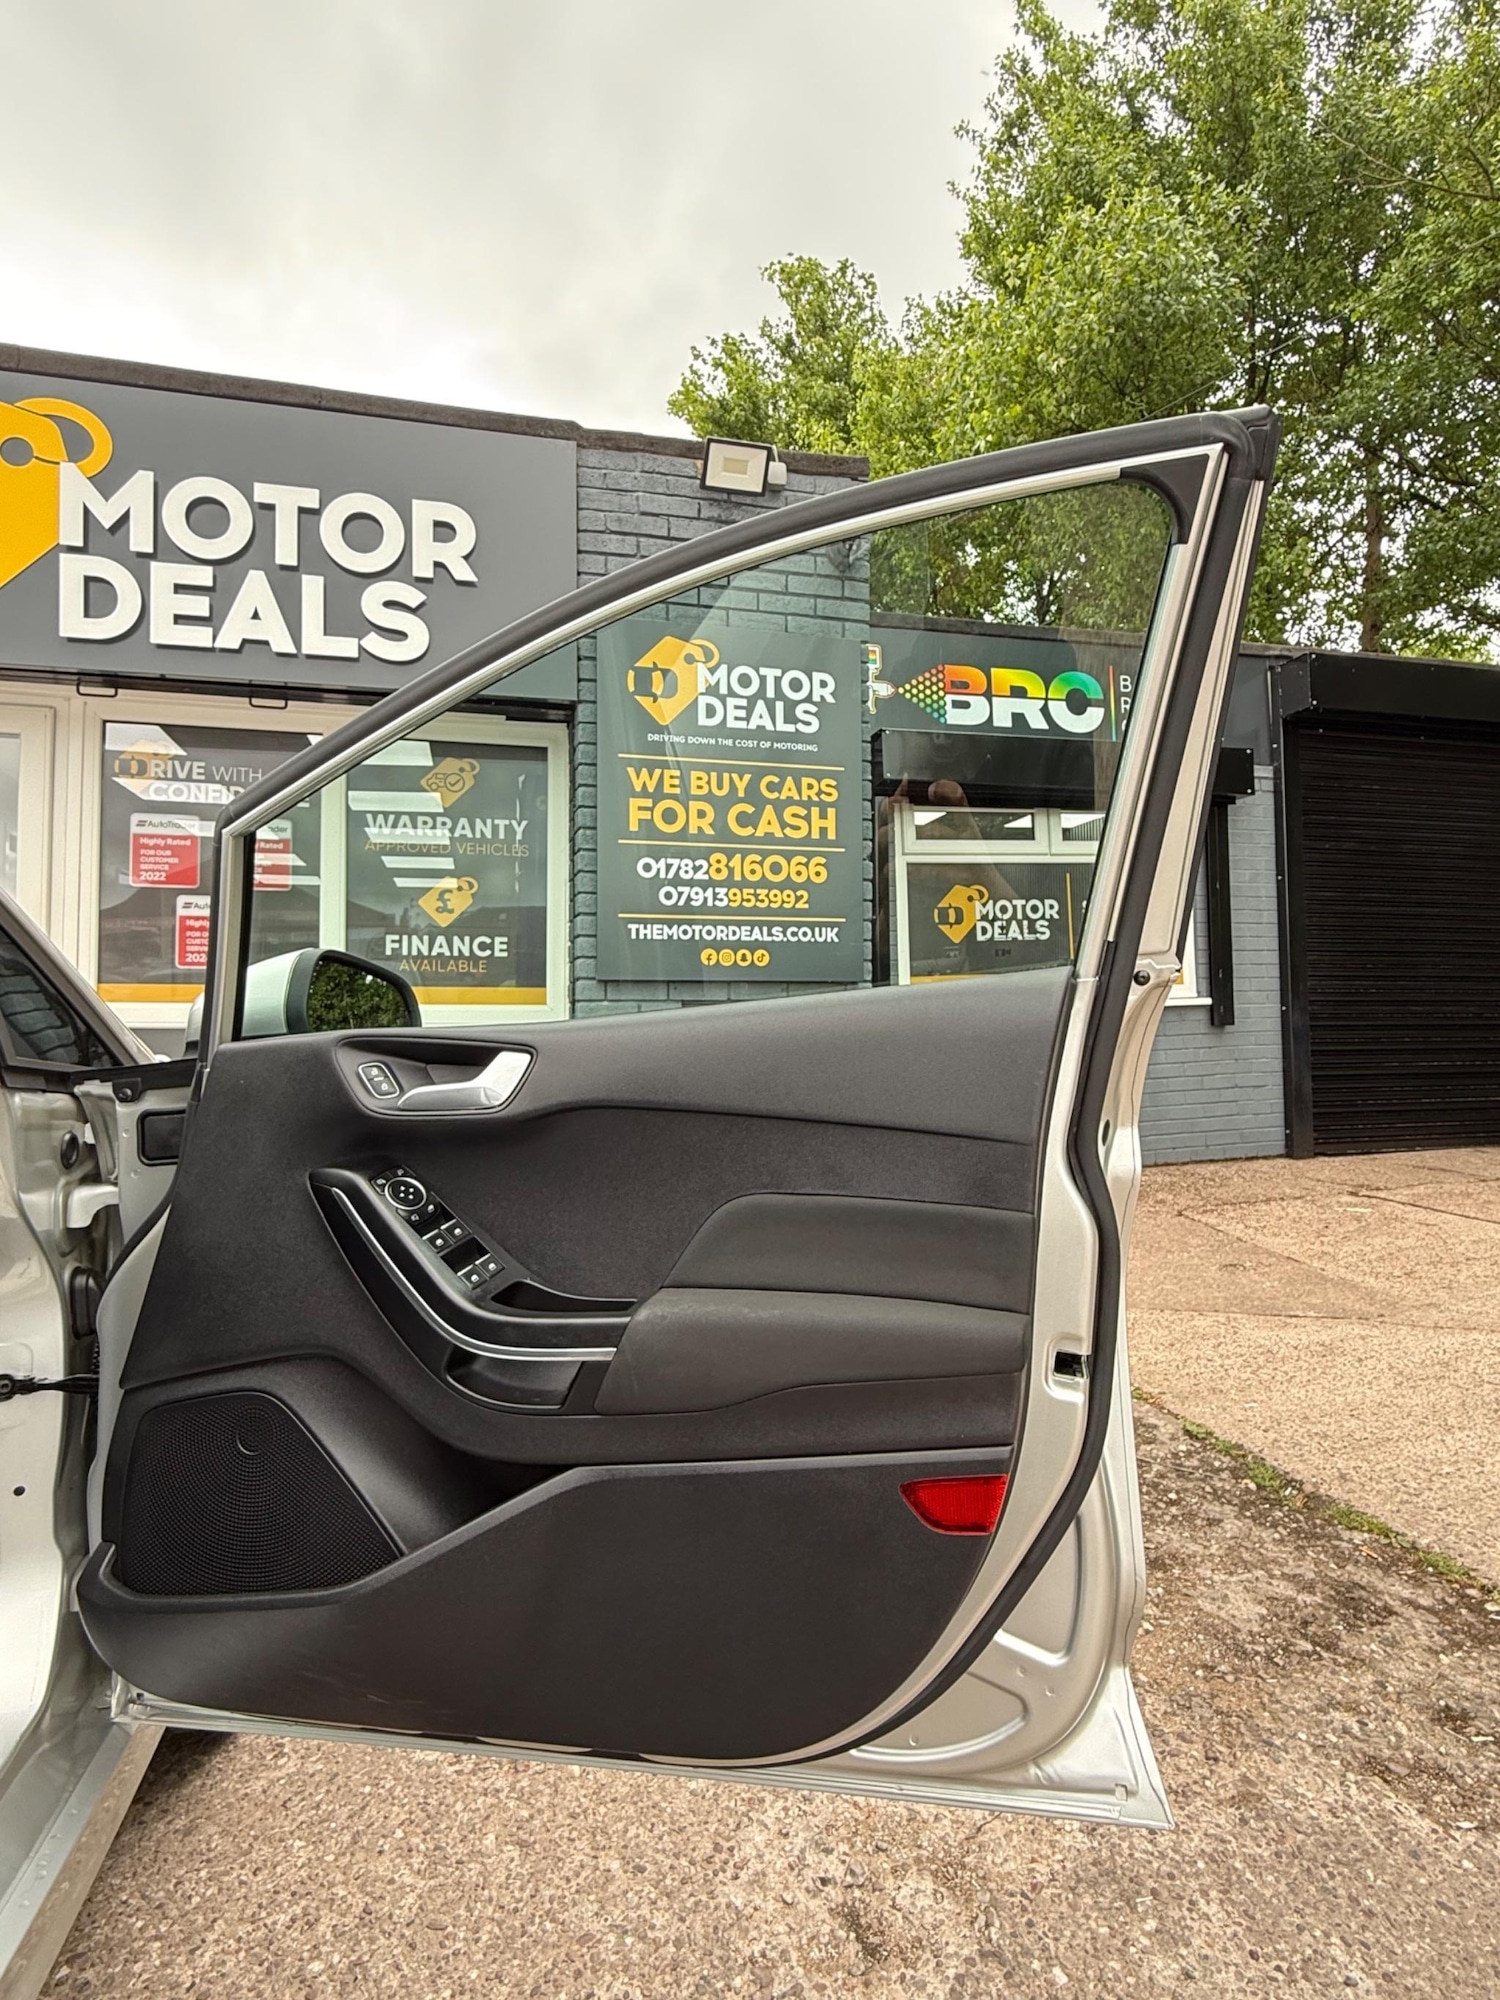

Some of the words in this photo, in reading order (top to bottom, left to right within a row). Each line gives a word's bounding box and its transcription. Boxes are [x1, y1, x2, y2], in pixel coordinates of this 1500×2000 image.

[59, 461, 479, 583] MOTOR
[59, 552, 431, 662] DEALS
[696, 661, 836, 703] MOTOR
[944, 664, 1105, 734] BRC
[697, 694, 820, 734] DEALS
[647, 733, 686, 743] DRIVING
[687, 736, 716, 745] DOWN
[717, 738, 733, 747] THE
[735, 739, 758, 748] COST
[773, 742, 819, 752] MOTORING
[212, 766, 262, 783] WITH
[626, 767, 681, 794] WE
[690, 770, 752, 798] BUY
[759, 774, 839, 802] CARS
[365, 813, 528, 840] WARRANTY
[628, 798, 716, 835] FOR
[727, 802, 837, 840] CASH
[139, 837, 166, 847] Highly
[167, 838, 192, 847] Rated
[260, 842, 284, 850] Rated
[364, 840, 451, 855] APPROVED
[456, 842, 530, 857] VEHICLES
[140, 856, 179, 864] CUSTOMER
[636, 852, 828, 884] 01782816066
[139, 871, 167, 881] 2022
[658, 885, 809, 909] 07913953992
[974, 899, 1060, 920] MOTOR
[627, 923, 840, 943] THEMOTORDEALS.CO.UK
[976, 921, 1051, 942] DEALS
[385, 934, 508, 957] FINANCE
[185, 953, 207, 963] 202
[399, 959, 487, 972] AVAILABLE
